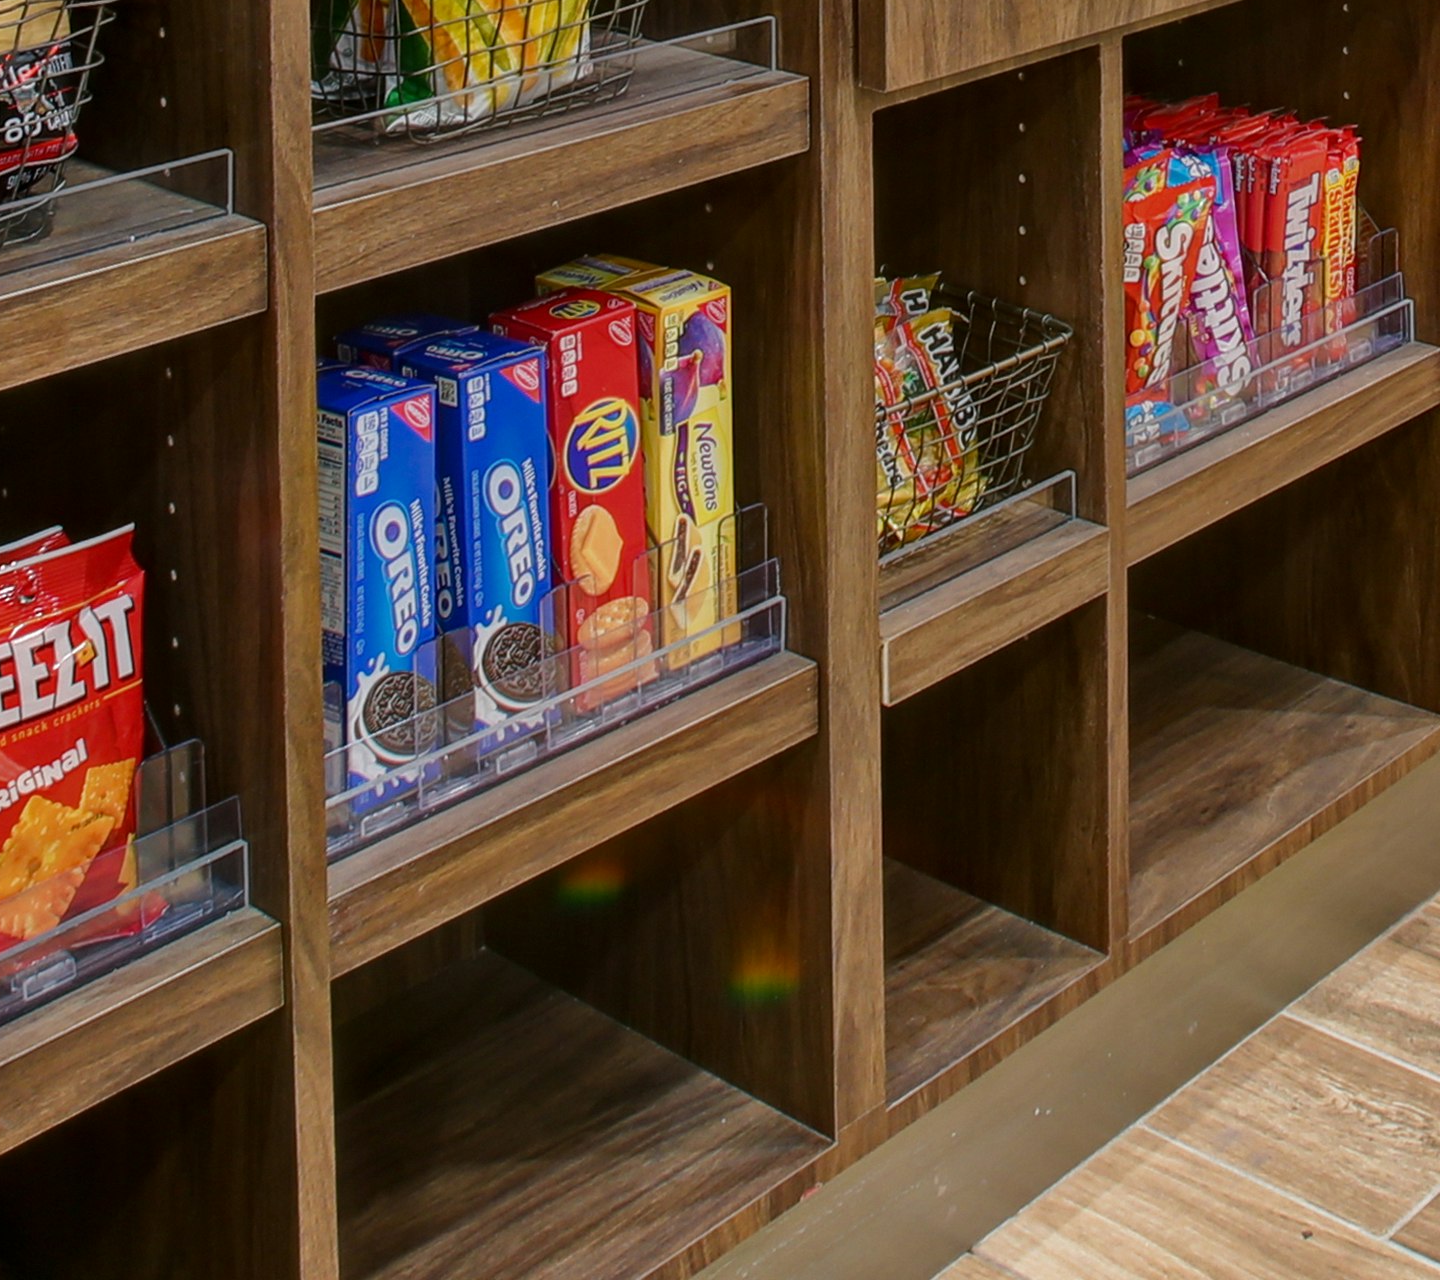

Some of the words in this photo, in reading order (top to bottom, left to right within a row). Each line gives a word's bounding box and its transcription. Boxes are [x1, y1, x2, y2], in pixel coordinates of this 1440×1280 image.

[321, 413, 343, 428] Facts
[574, 398, 632, 490] RITZ
[676, 466, 687, 493] FIG
[693, 422, 718, 512] Newtons
[488, 462, 535, 608] OREO
[526, 492, 542, 539] Favorite
[413, 535, 429, 585] Favorite
[435, 484, 454, 620] REO
[533, 538, 545, 582] Cookie
[374, 503, 419, 656] OREO
[419, 584, 433, 629] Cookie
[10, 721, 50, 748] snack
[52, 699, 101, 727] crackers
